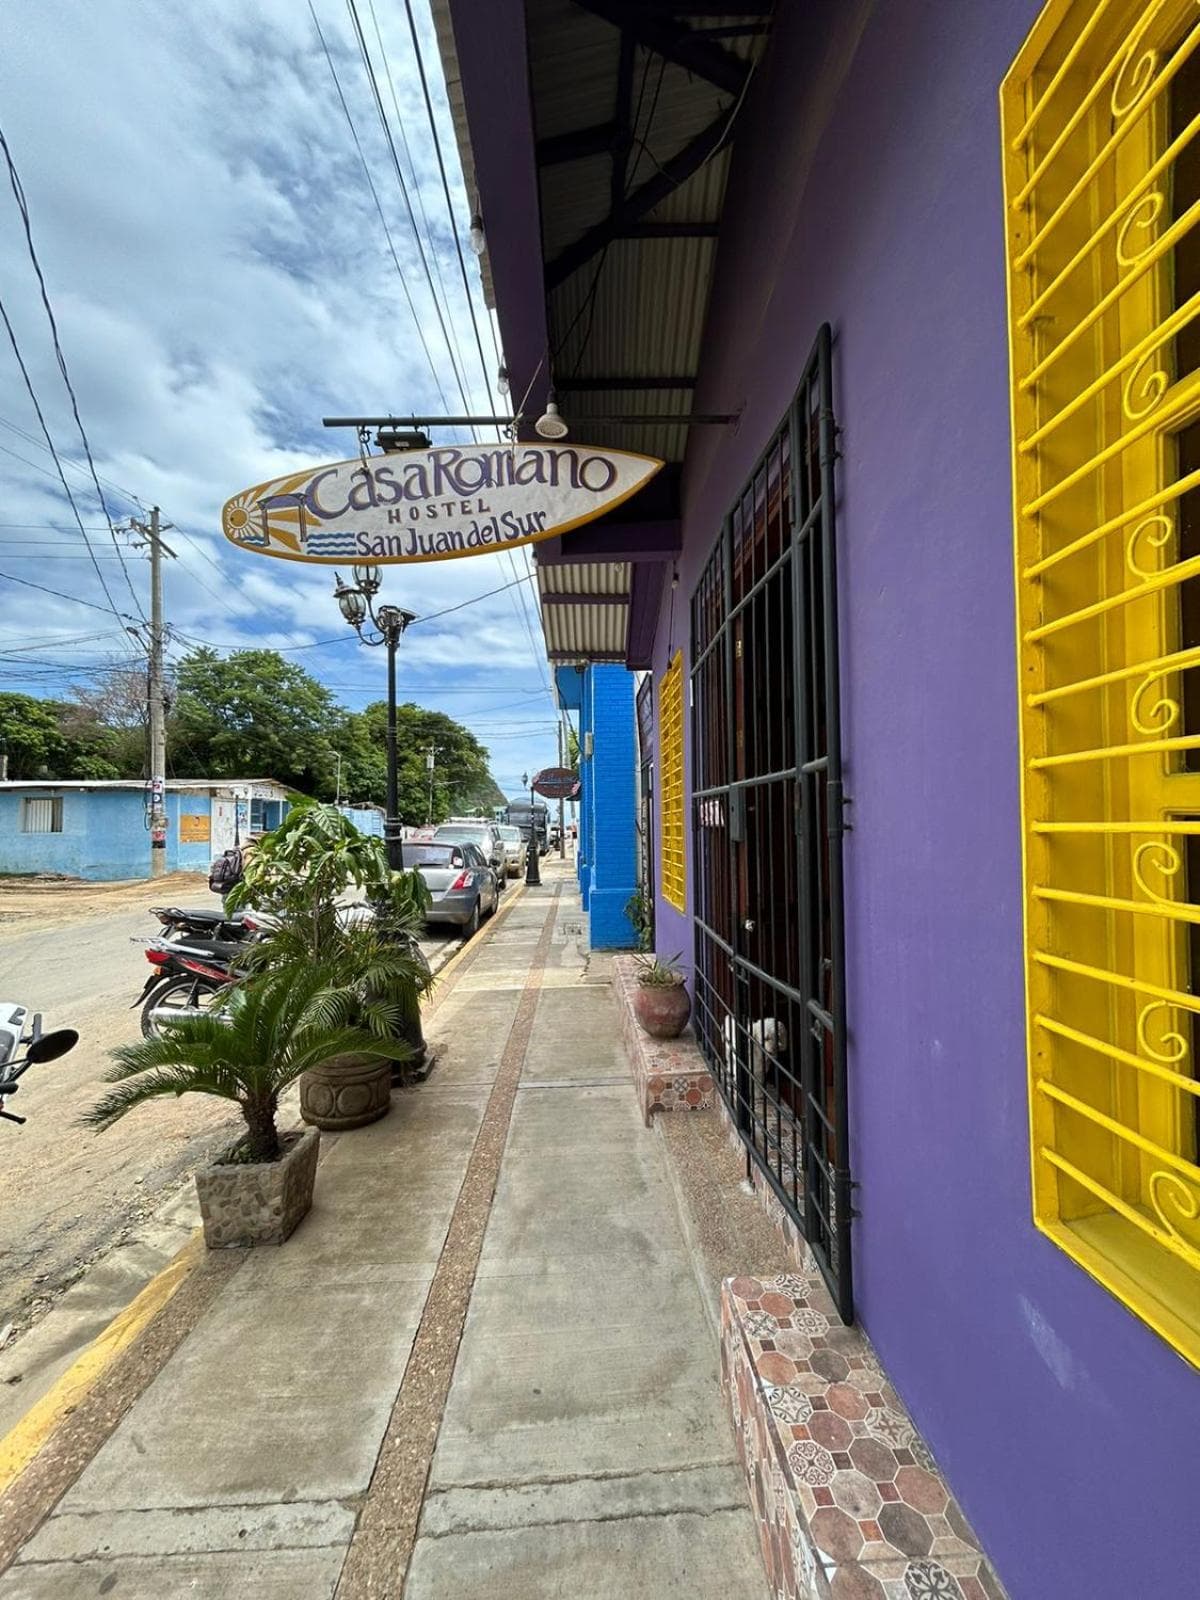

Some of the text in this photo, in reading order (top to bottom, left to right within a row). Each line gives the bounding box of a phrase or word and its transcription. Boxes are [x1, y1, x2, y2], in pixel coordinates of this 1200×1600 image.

[387, 499, 491, 524] HOSTEL
[356, 531, 402, 557] San
[501, 510, 547, 539] Sur
